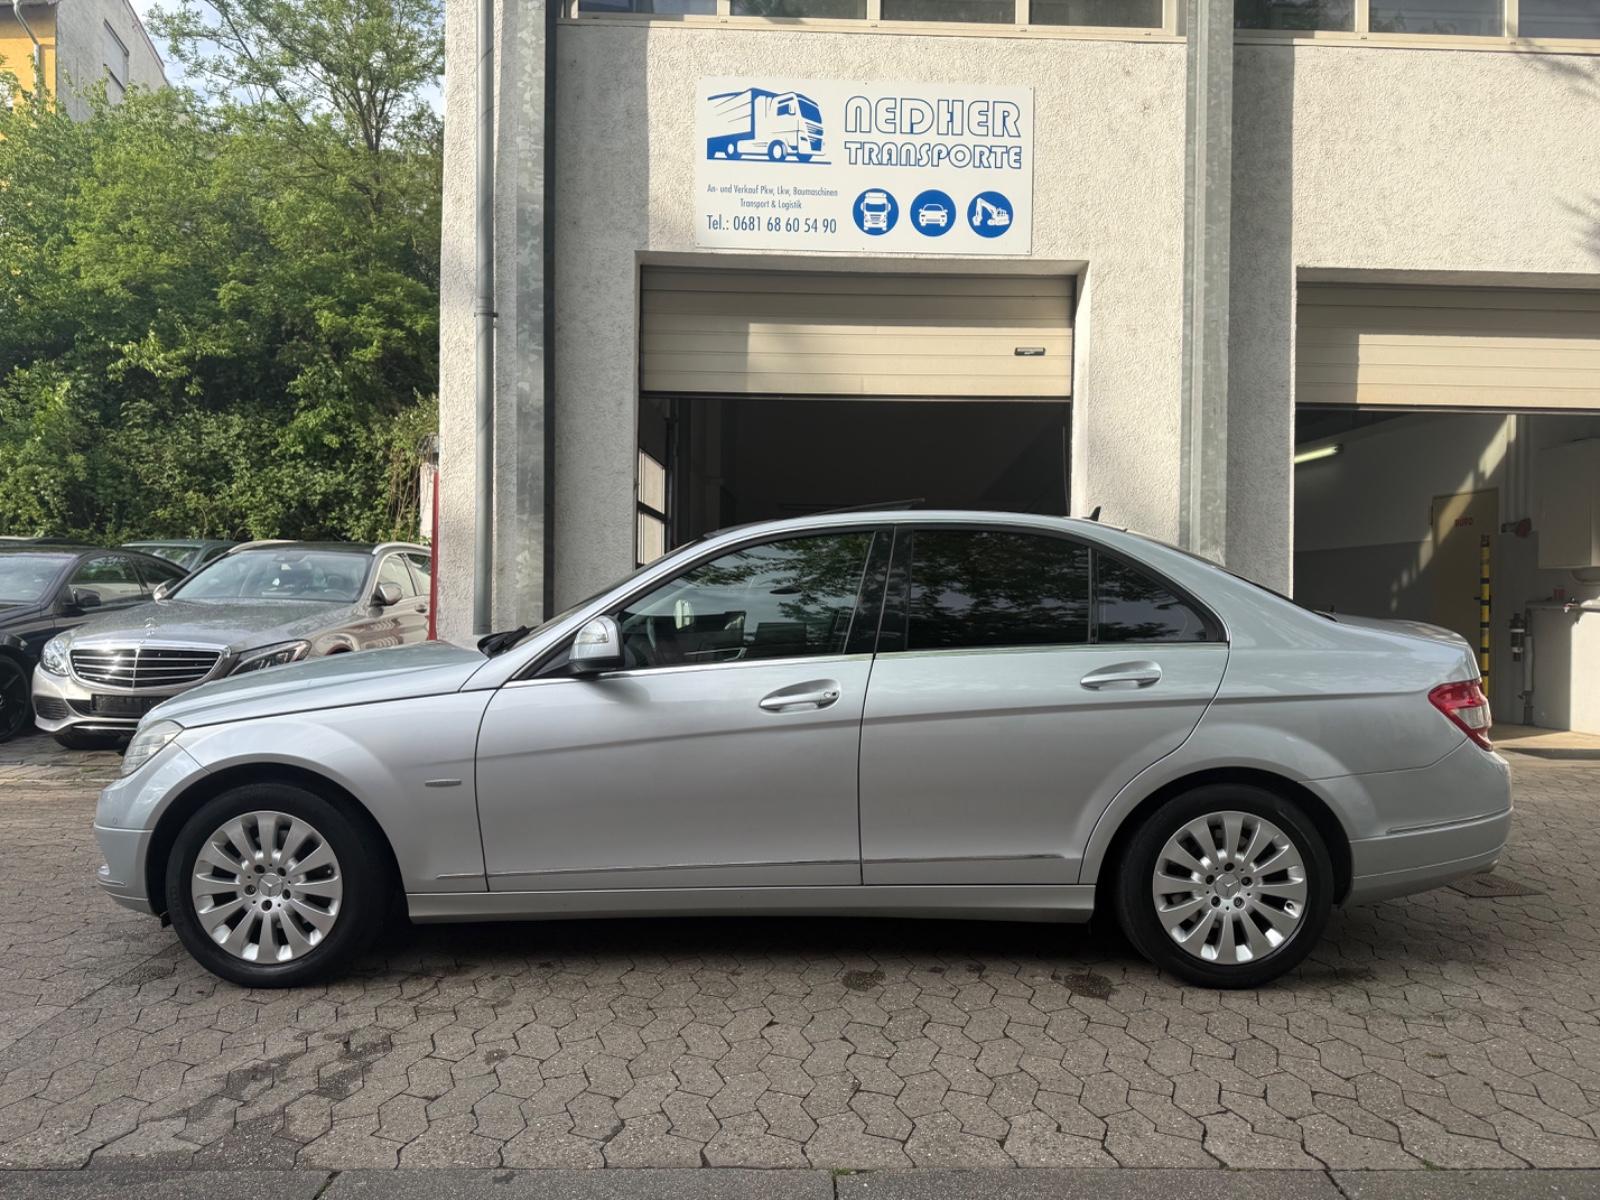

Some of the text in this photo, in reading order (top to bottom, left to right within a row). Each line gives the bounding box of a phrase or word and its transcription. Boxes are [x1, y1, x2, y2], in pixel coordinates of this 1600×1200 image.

[844, 95, 1021, 138] NEDHER
[844, 140, 1022, 170] TRANSPORTE
[707, 184, 838, 197] An- und Verkauf Pkw, Lkw, Baumaschinen
[740, 198, 802, 210] Transport & Logistik
[707, 214, 837, 234] Tel.: 0681 68 60 54 90
